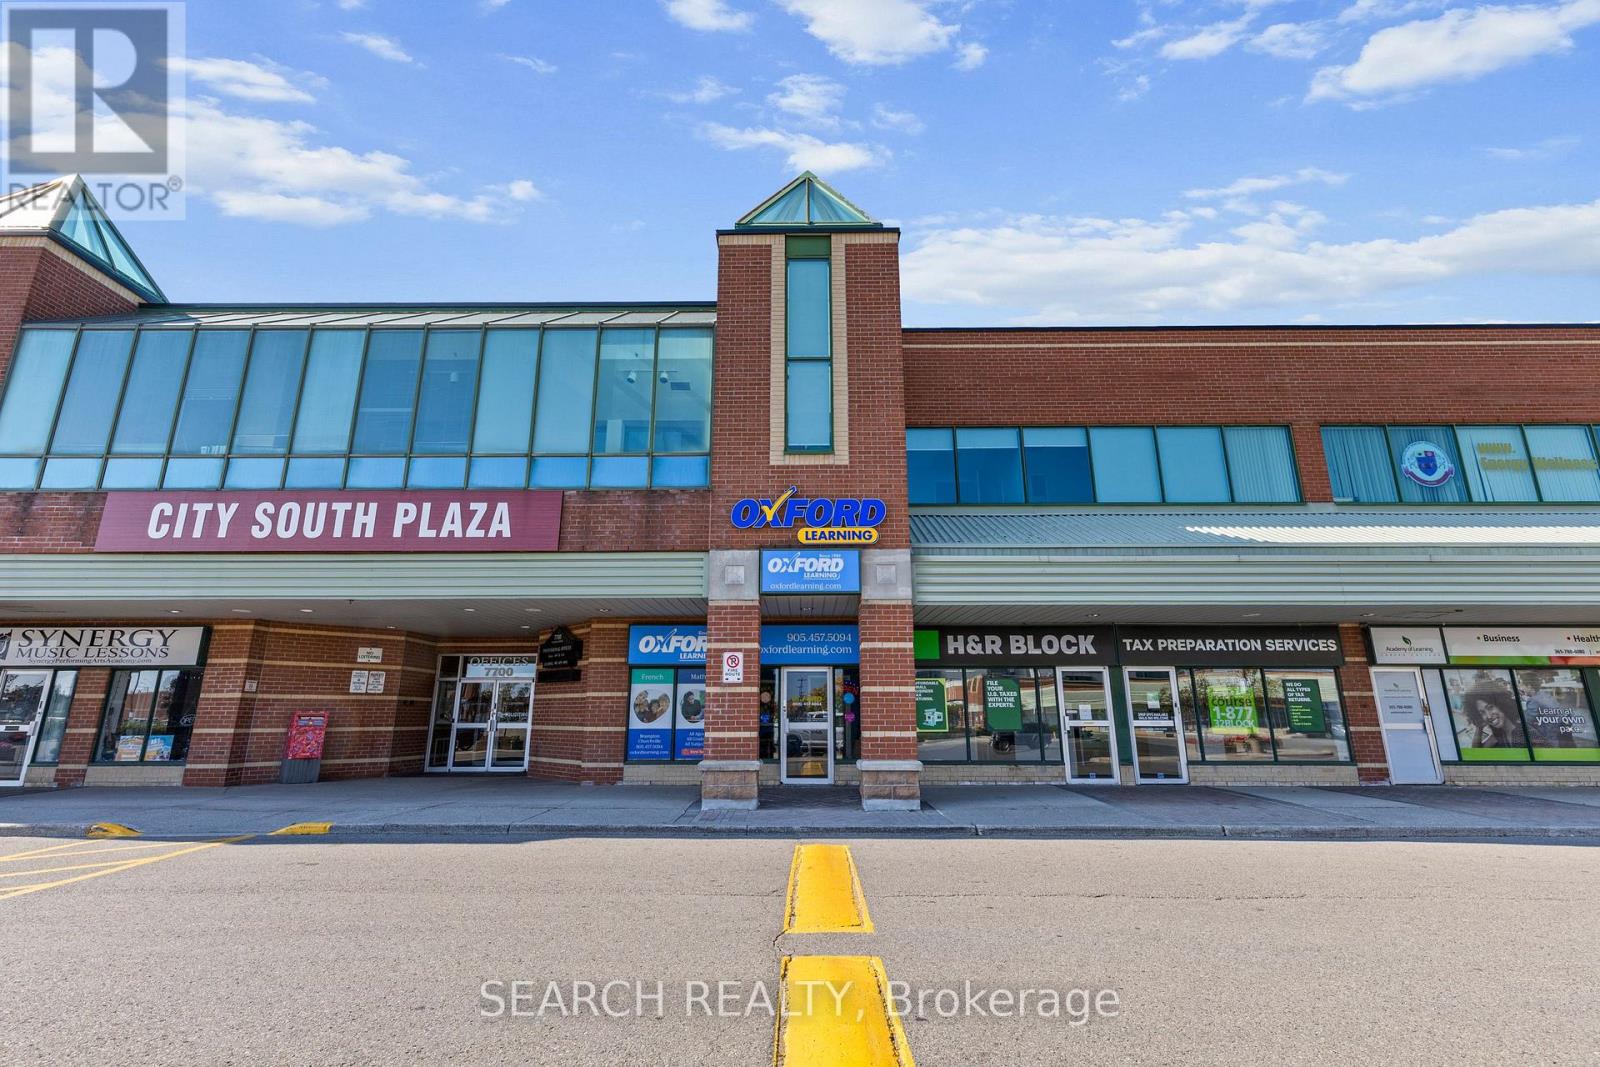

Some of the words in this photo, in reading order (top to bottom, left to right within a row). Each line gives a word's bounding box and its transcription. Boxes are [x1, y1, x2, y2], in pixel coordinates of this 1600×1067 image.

[731, 486, 886, 528] OXFORD
[147, 502, 240, 539] CITY
[250, 502, 378, 539] SOUTH
[392, 502, 511, 538] PLAZA
[805, 530, 873, 541] LEARNING
[767, 552, 844, 573] OXFORD
[770, 582, 842, 591] oxfordlearning.com
[18, 629, 179, 648] SYNERGY
[639, 628, 707, 653] OXFOR
[787, 633, 852, 642] 905.457.5094
[1483, 634, 1520, 643] Business
[947, 635, 1003, 655] H&R
[1009, 634, 1097, 655] BLOCK
[1122, 639, 1154, 651] TAX
[1158, 639, 1262, 651] PREPARATION
[1265, 639, 1337, 651] SERVICES
[15, 647, 79, 659] MUSIC
[84, 647, 170, 659] LESSONS
[680, 652, 706, 660] LEARNI
[469, 656, 529, 667] OFFICES
[485, 667, 514, 676] 7700
[1211, 698, 1252, 707] course
[1538, 707, 1562, 715] Learn
[1536, 716, 1559, 726] your
[1562, 716, 1585, 724] own
